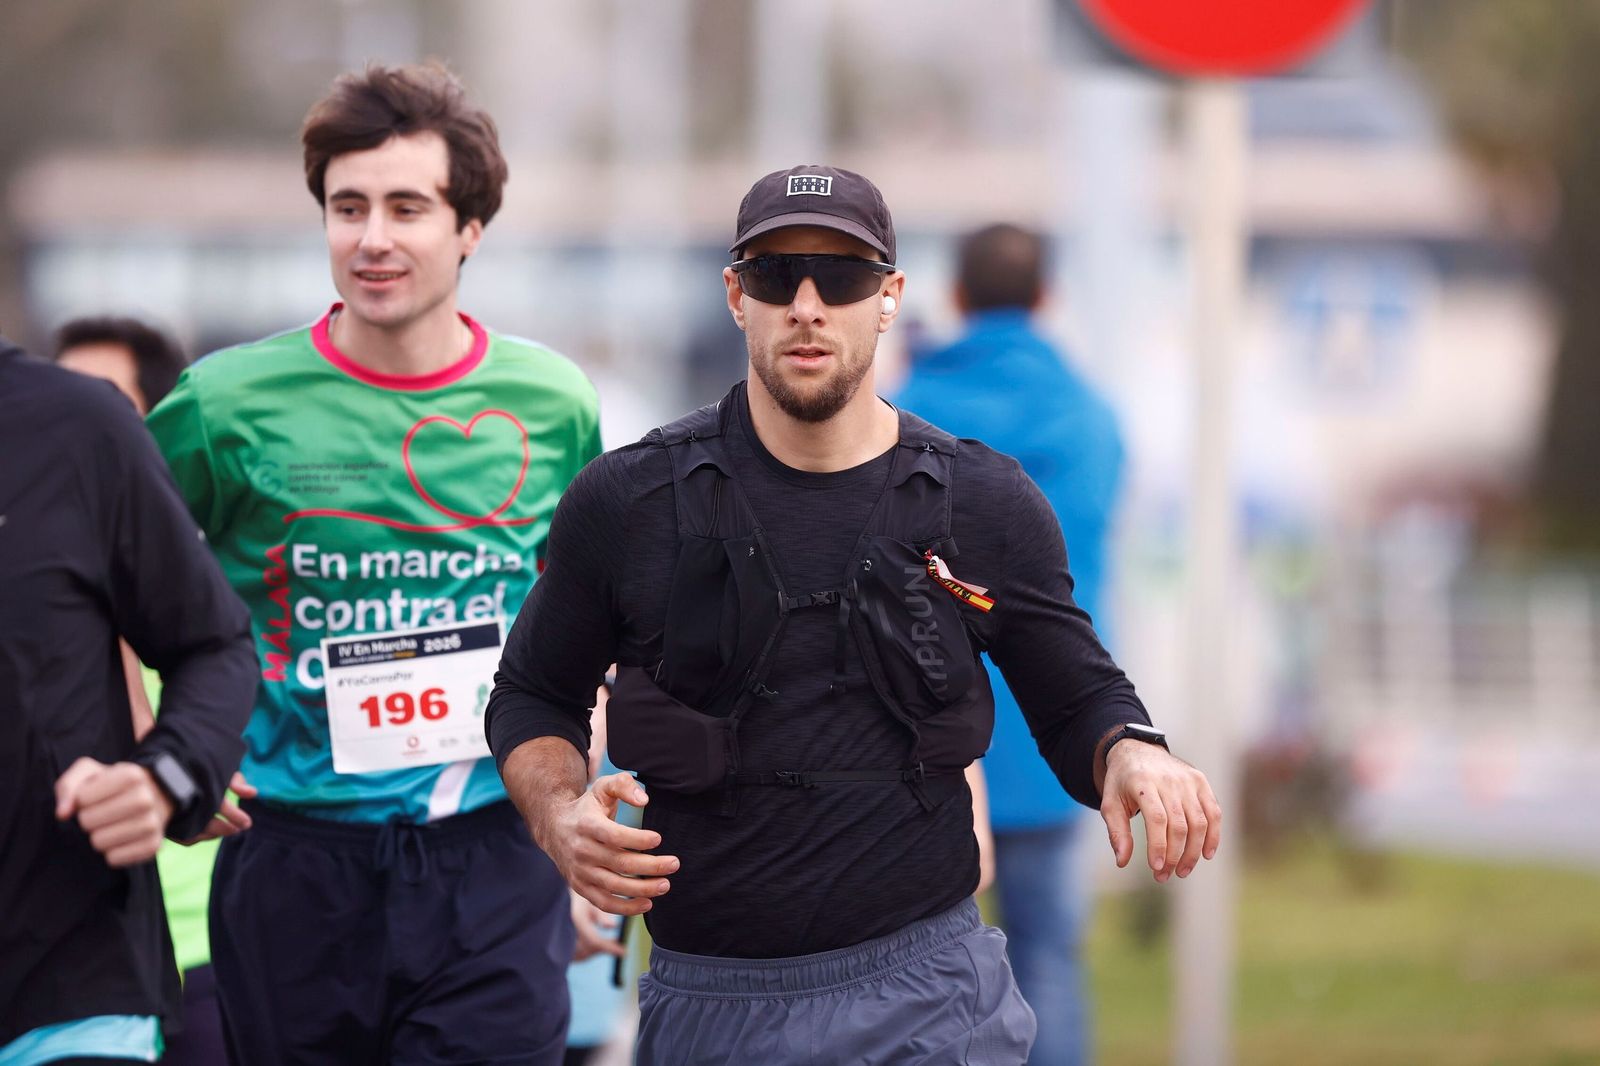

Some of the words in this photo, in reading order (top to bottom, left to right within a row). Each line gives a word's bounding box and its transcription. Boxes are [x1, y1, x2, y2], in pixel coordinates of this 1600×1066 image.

[293, 544, 348, 580] En
[360, 543, 523, 580] marcha
[262, 544, 291, 681] MÁLAGA
[295, 588, 457, 631] contra
[464, 580, 506, 622] el
[338, 644, 353, 657] IV
[353, 642, 371, 656] En
[371, 637, 418, 654] Marcha
[424, 633, 462, 653] 2026
[359, 687, 449, 728] 196
